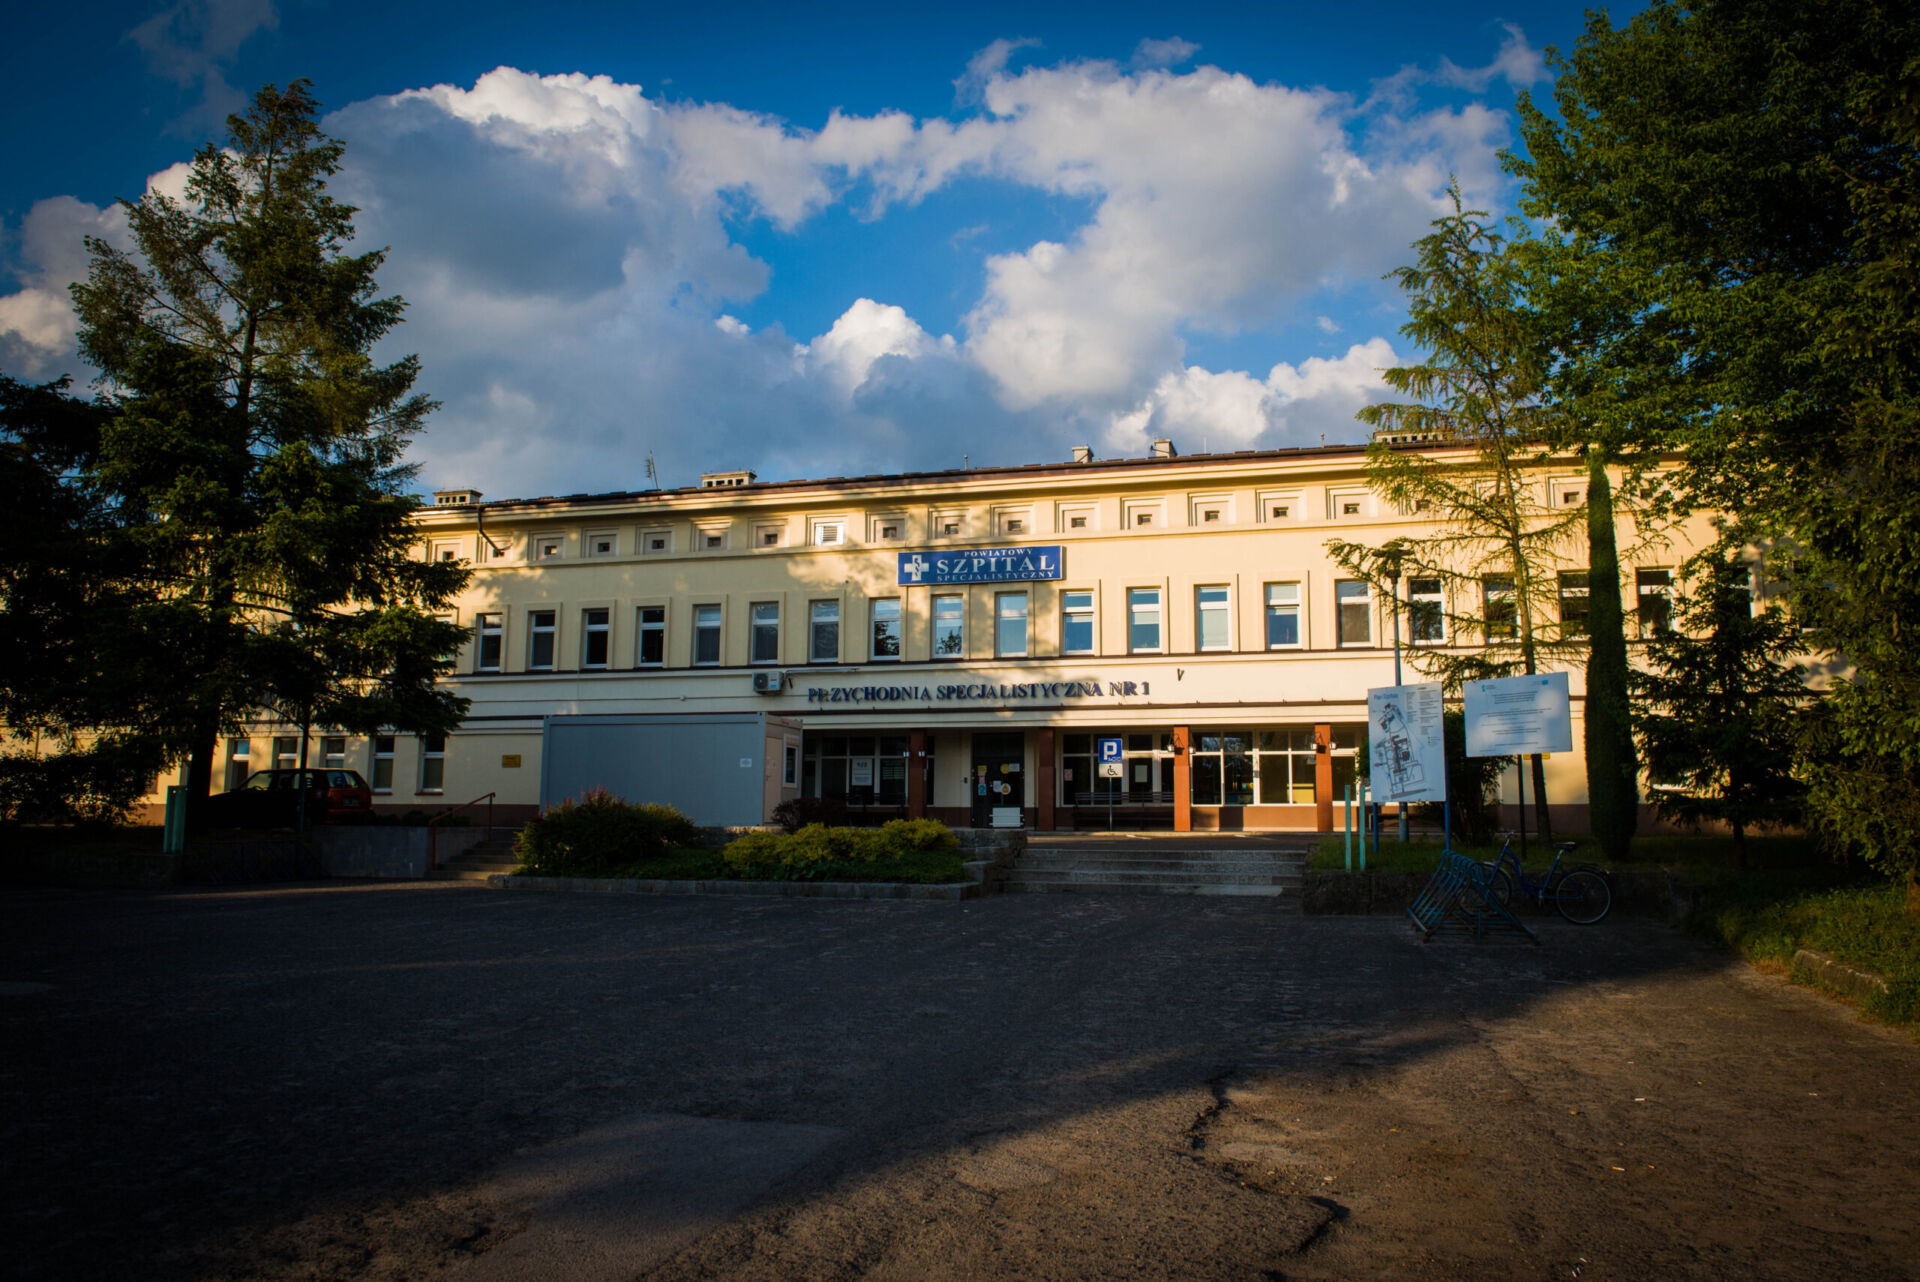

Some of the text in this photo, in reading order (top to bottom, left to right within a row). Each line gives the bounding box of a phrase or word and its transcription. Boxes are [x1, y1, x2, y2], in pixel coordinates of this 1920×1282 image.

[964, 548, 1032, 557] POWIATOWY
[936, 555, 1055, 574] SZPITAL
[937, 571, 1054, 582] SPECJALISTYCZNY
[808, 681, 1150, 703] PRZYCHODNIA SPECJALISTYCZNA NR 1
[1103, 741, 1118, 761] P
